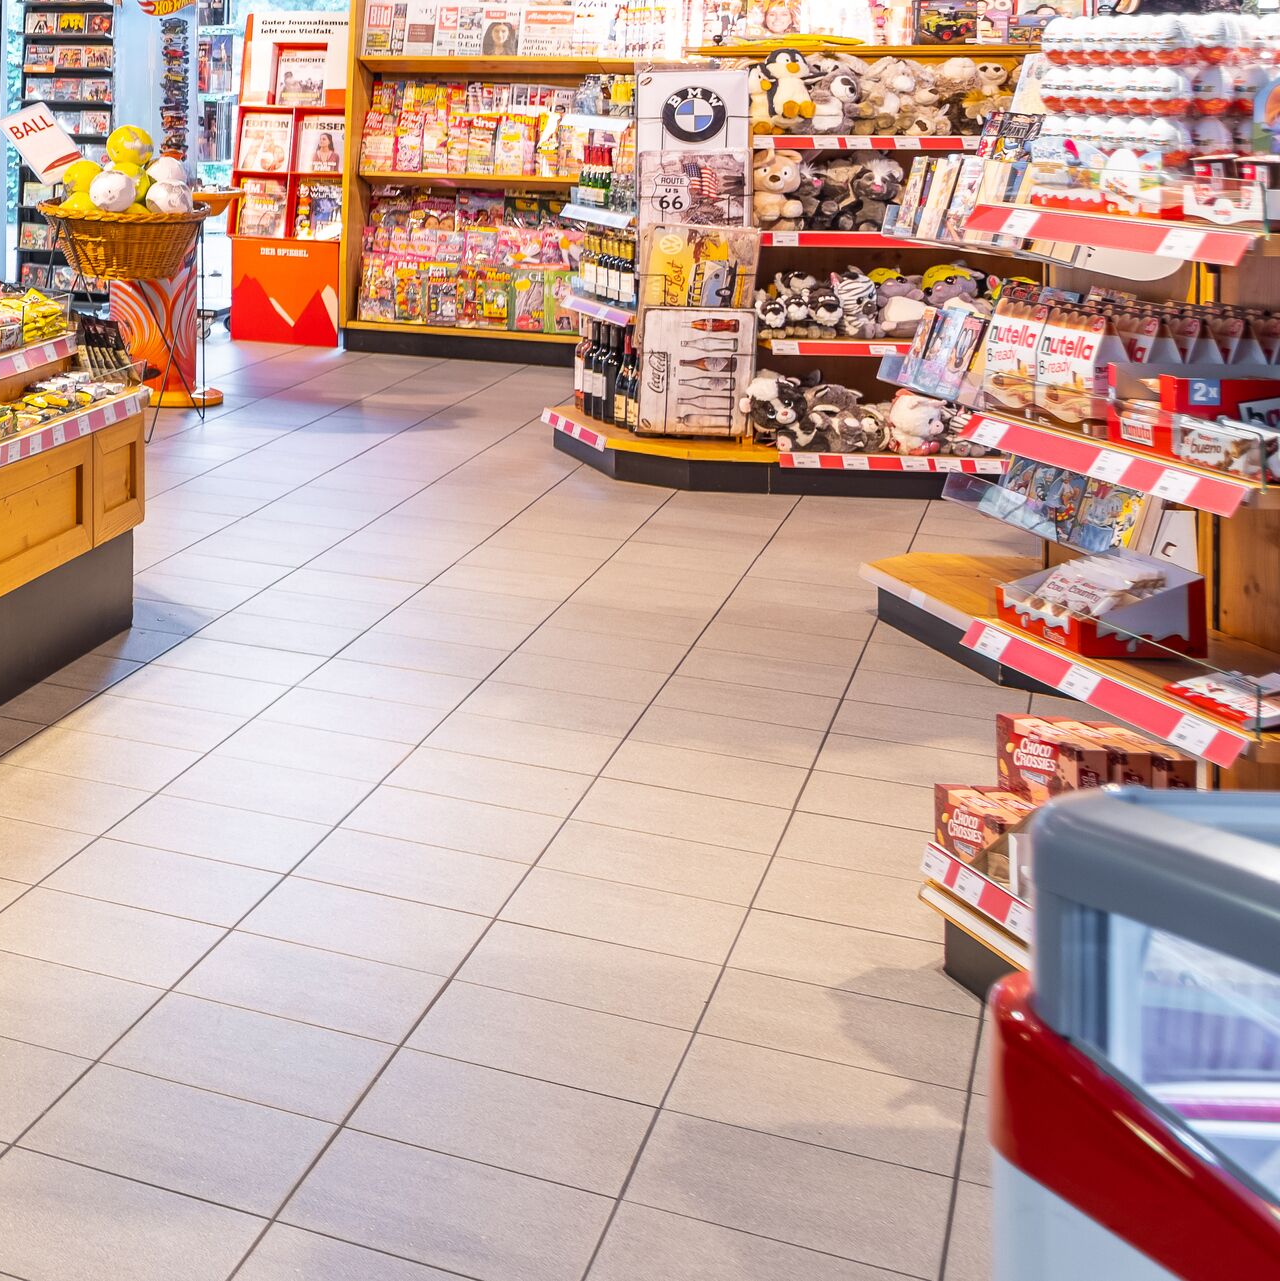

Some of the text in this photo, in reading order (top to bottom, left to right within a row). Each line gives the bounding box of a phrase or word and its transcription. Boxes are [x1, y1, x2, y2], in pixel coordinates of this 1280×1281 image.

[369, 5, 392, 27] Bild
[441, 8, 458, 27] tz
[667, 87, 724, 108] BMW
[8, 114, 55, 140] BALL
[245, 120, 289, 129] EDITION
[473, 117, 497, 129] tina
[660, 176, 685, 185] ROUTE
[658, 195, 684, 210] 66
[260, 247, 309, 258] DER SPIEGEL
[668, 260, 685, 291] Lost
[990, 320, 1038, 347] nutella
[1040, 333, 1095, 362] nutella
[1193, 382, 1218, 402] 2x
[1122, 421, 1152, 441] hanuta
[1190, 440, 1222, 454] bueno
[1068, 583, 1102, 604] Country
[1020, 737, 1053, 757] CHOCO
[1013, 749, 1056, 772] CROSSIES
[952, 808, 979, 830] CHOCO
[948, 818, 982, 843] CROSSIES
